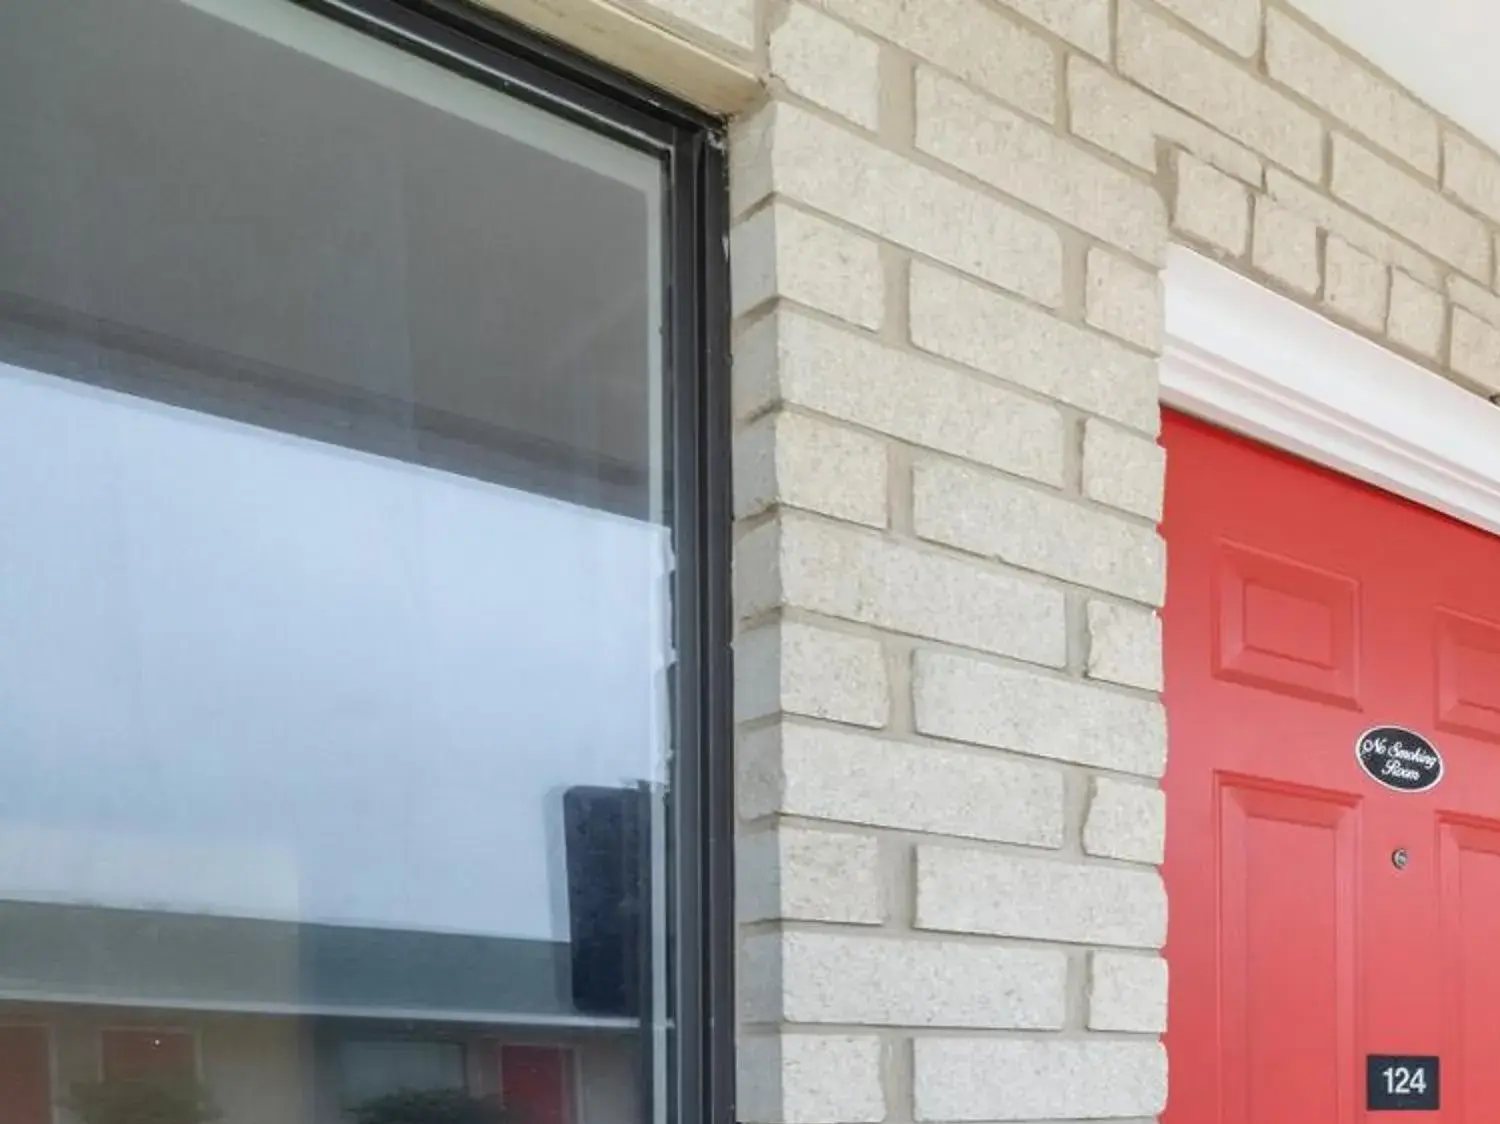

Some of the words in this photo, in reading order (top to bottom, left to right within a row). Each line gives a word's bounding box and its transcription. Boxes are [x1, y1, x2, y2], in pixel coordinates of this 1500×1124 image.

[1381, 759, 1420, 780] Room
[1388, 741, 1437, 770] Smoking
[1382, 1066, 1427, 1094] 124
